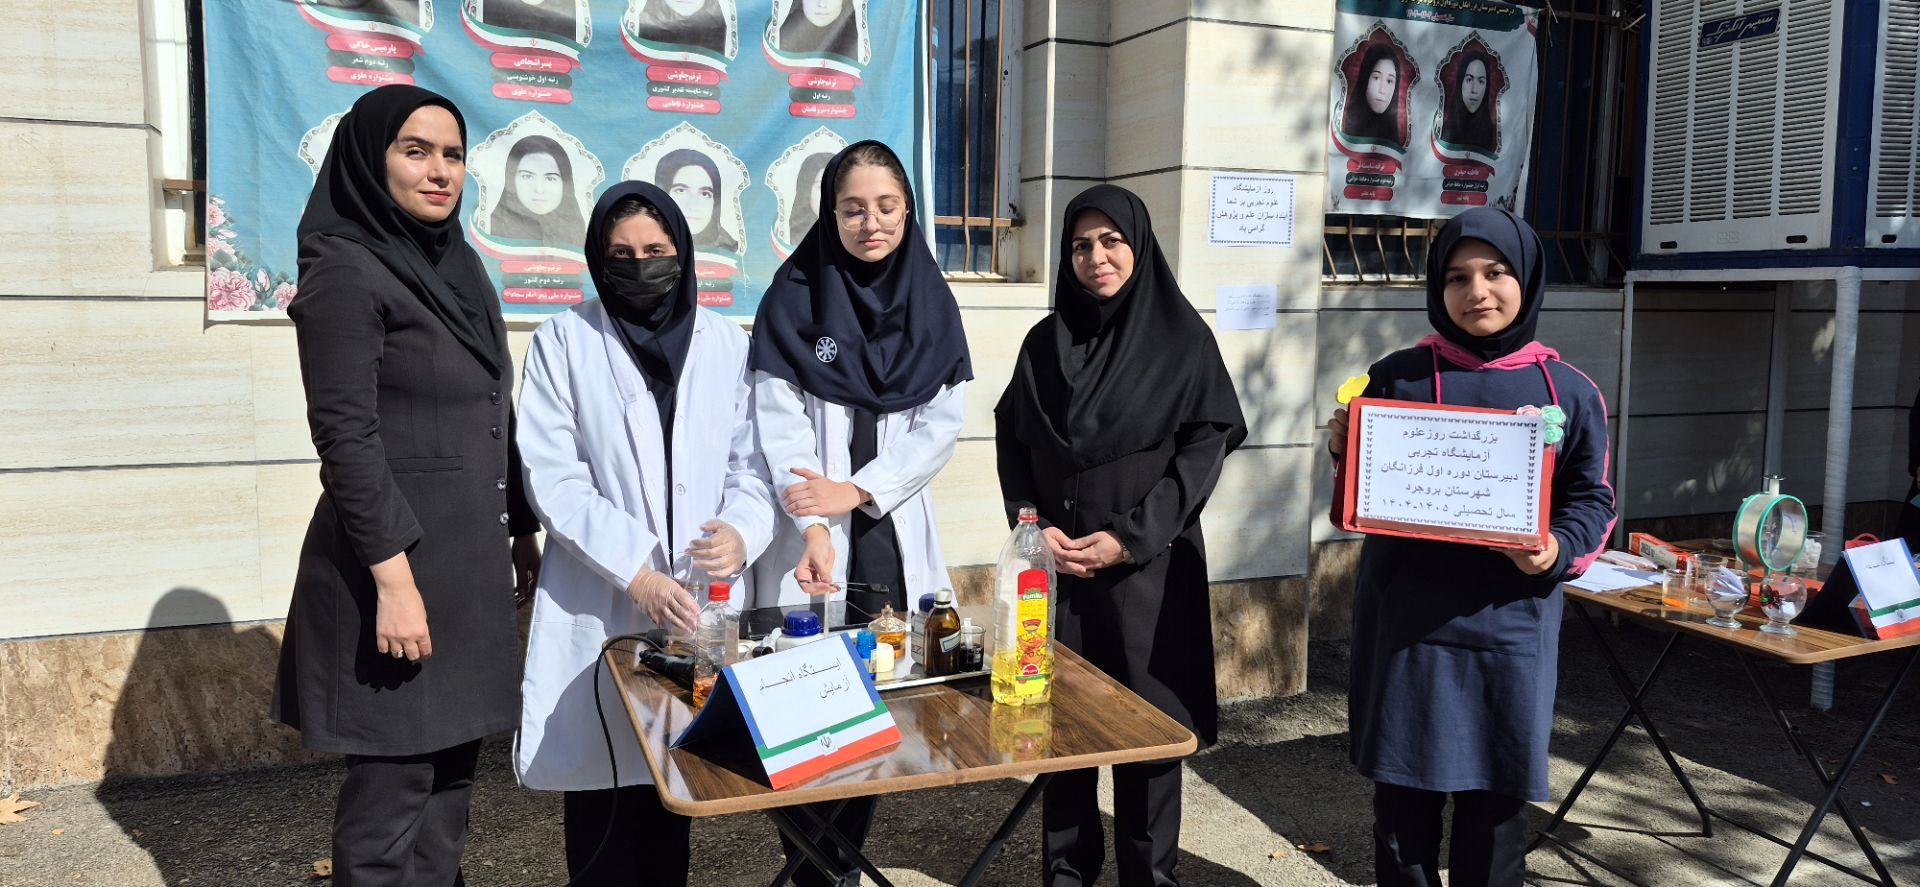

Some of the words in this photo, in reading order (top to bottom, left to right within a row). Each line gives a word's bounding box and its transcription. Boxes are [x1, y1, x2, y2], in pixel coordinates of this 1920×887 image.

[537, 75, 547, 83] اول
[702, 89, 713, 97] رتبه
[1403, 427, 1425, 439] علوم
[1427, 429, 1445, 441] روز
[1448, 429, 1498, 444] بزرگداشت
[1407, 448, 1438, 459] تجربی
[1380, 460, 1424, 475] فرزانگان
[1426, 465, 1443, 477] اول
[1447, 469, 1470, 479] دوره
[1473, 469, 1518, 482] دبیرستان
[1405, 483, 1441, 496] بروجرد
[1444, 485, 1491, 500] شهرستان
[1453, 505, 1493, 518] تحصیلی
[1496, 508, 1516, 519] سال
